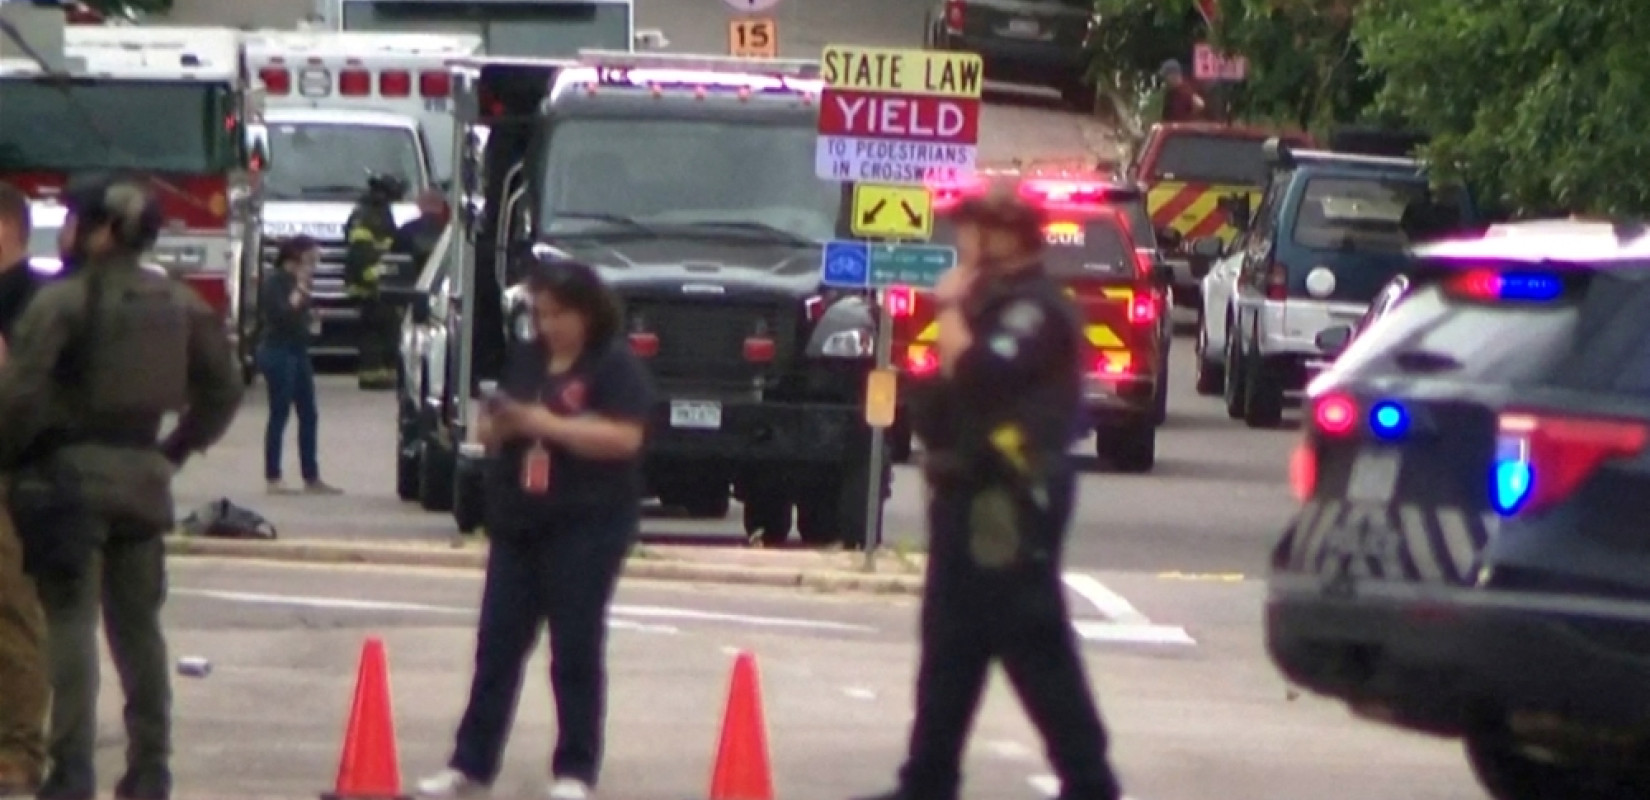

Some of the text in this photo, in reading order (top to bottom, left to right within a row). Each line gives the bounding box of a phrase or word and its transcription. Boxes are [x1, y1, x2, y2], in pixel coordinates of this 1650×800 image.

[736, 24, 769, 48] 15
[824, 50, 979, 92] STATE LAW
[835, 95, 965, 136] YIELD
[828, 138, 967, 163] TO PEDESTRIANS
[832, 160, 957, 182] IN CROSSWALK
